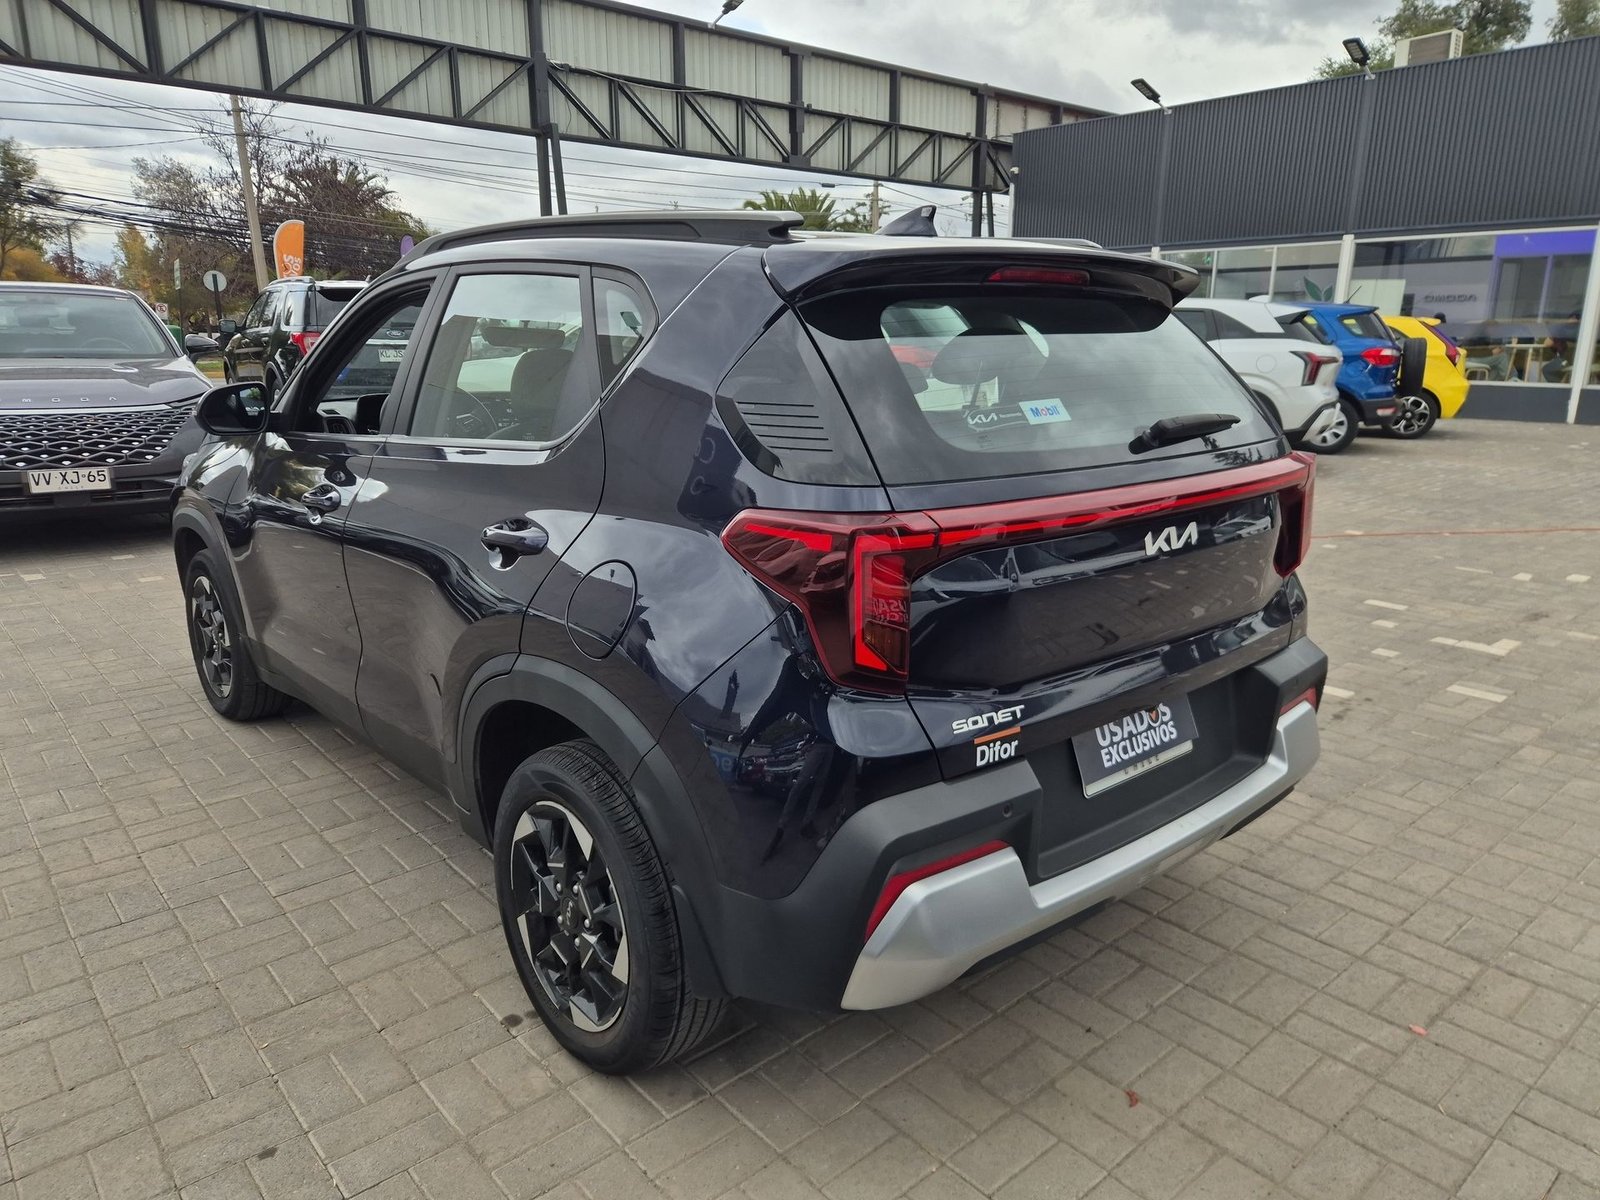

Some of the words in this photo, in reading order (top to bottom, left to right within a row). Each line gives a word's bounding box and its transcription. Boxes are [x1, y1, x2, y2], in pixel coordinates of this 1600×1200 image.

[1029, 405, 1060, 418] Mobil
[1144, 521, 1199, 556] KIA
[952, 704, 1025, 734] SONET
[1095, 702, 1171, 747] USADOS
[976, 740, 1018, 767] Difor
[1101, 721, 1177, 768] EXCLUSIVOS
